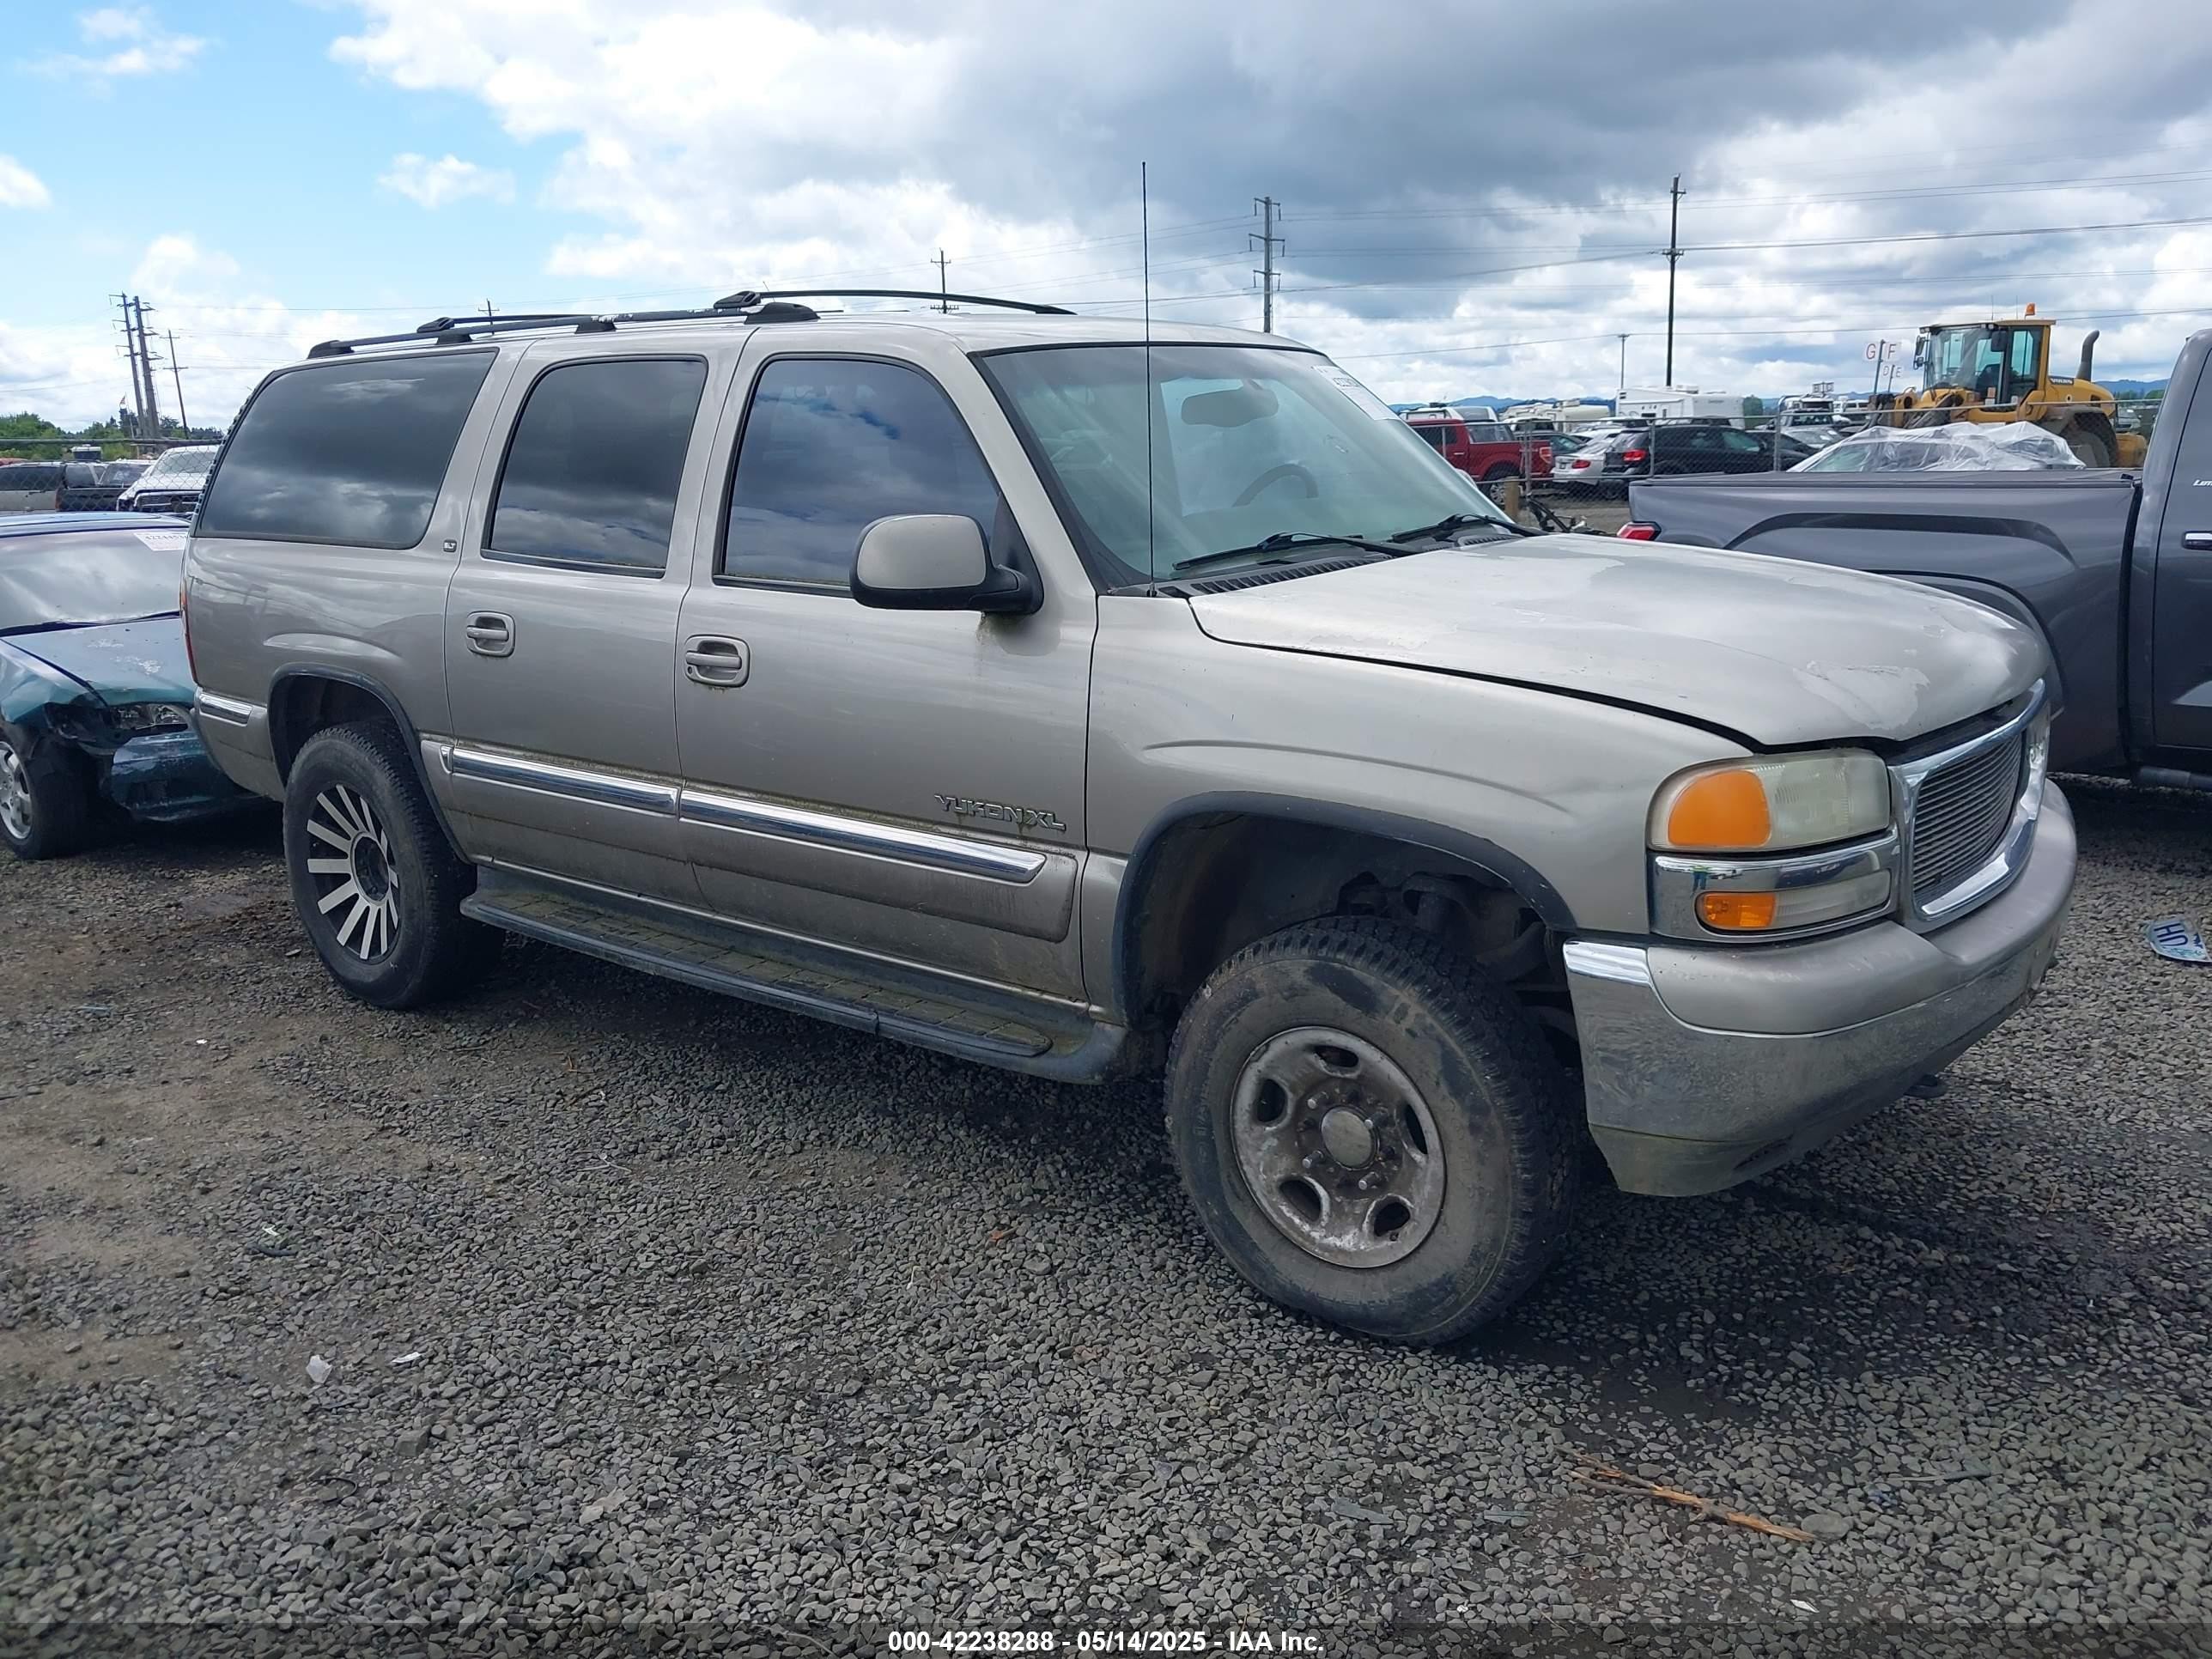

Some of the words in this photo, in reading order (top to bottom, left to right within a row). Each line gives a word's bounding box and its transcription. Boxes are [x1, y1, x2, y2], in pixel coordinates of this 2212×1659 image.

[1866, 343, 1876, 360] G
[1887, 343, 1897, 359] F
[934, 793, 1024, 824] YUKON
[1024, 809, 1066, 832] XL
